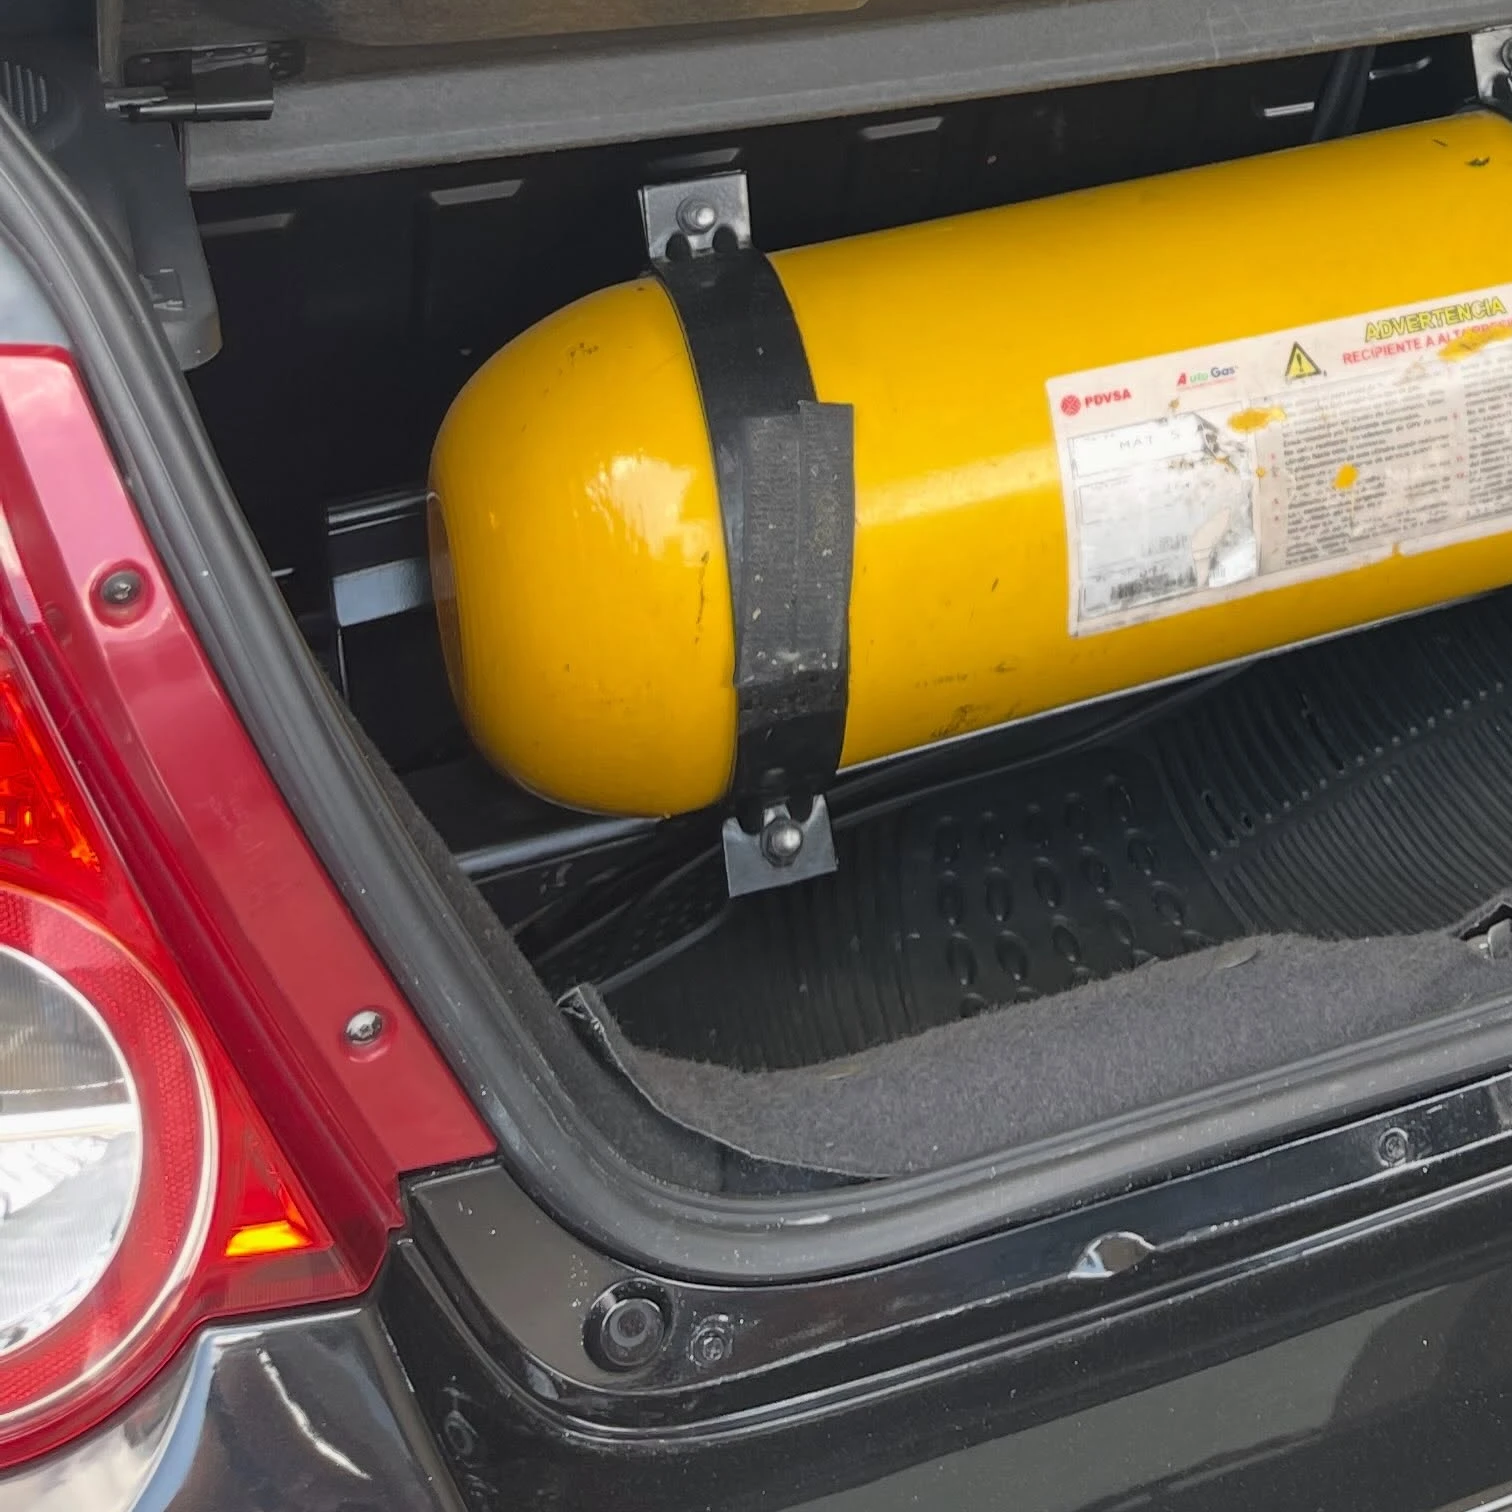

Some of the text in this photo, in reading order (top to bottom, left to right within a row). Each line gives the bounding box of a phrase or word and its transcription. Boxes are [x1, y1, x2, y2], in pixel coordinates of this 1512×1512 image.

[1365, 296, 1507, 343] ADVERTENCIA
[1343, 340, 1423, 364] RECIPIENTE
[1426, 335, 1435, 348] A
[1438, 328, 1469, 346] ALT
[1210, 366, 1236, 379] Gas
[1085, 389, 1132, 408] PDVSA
